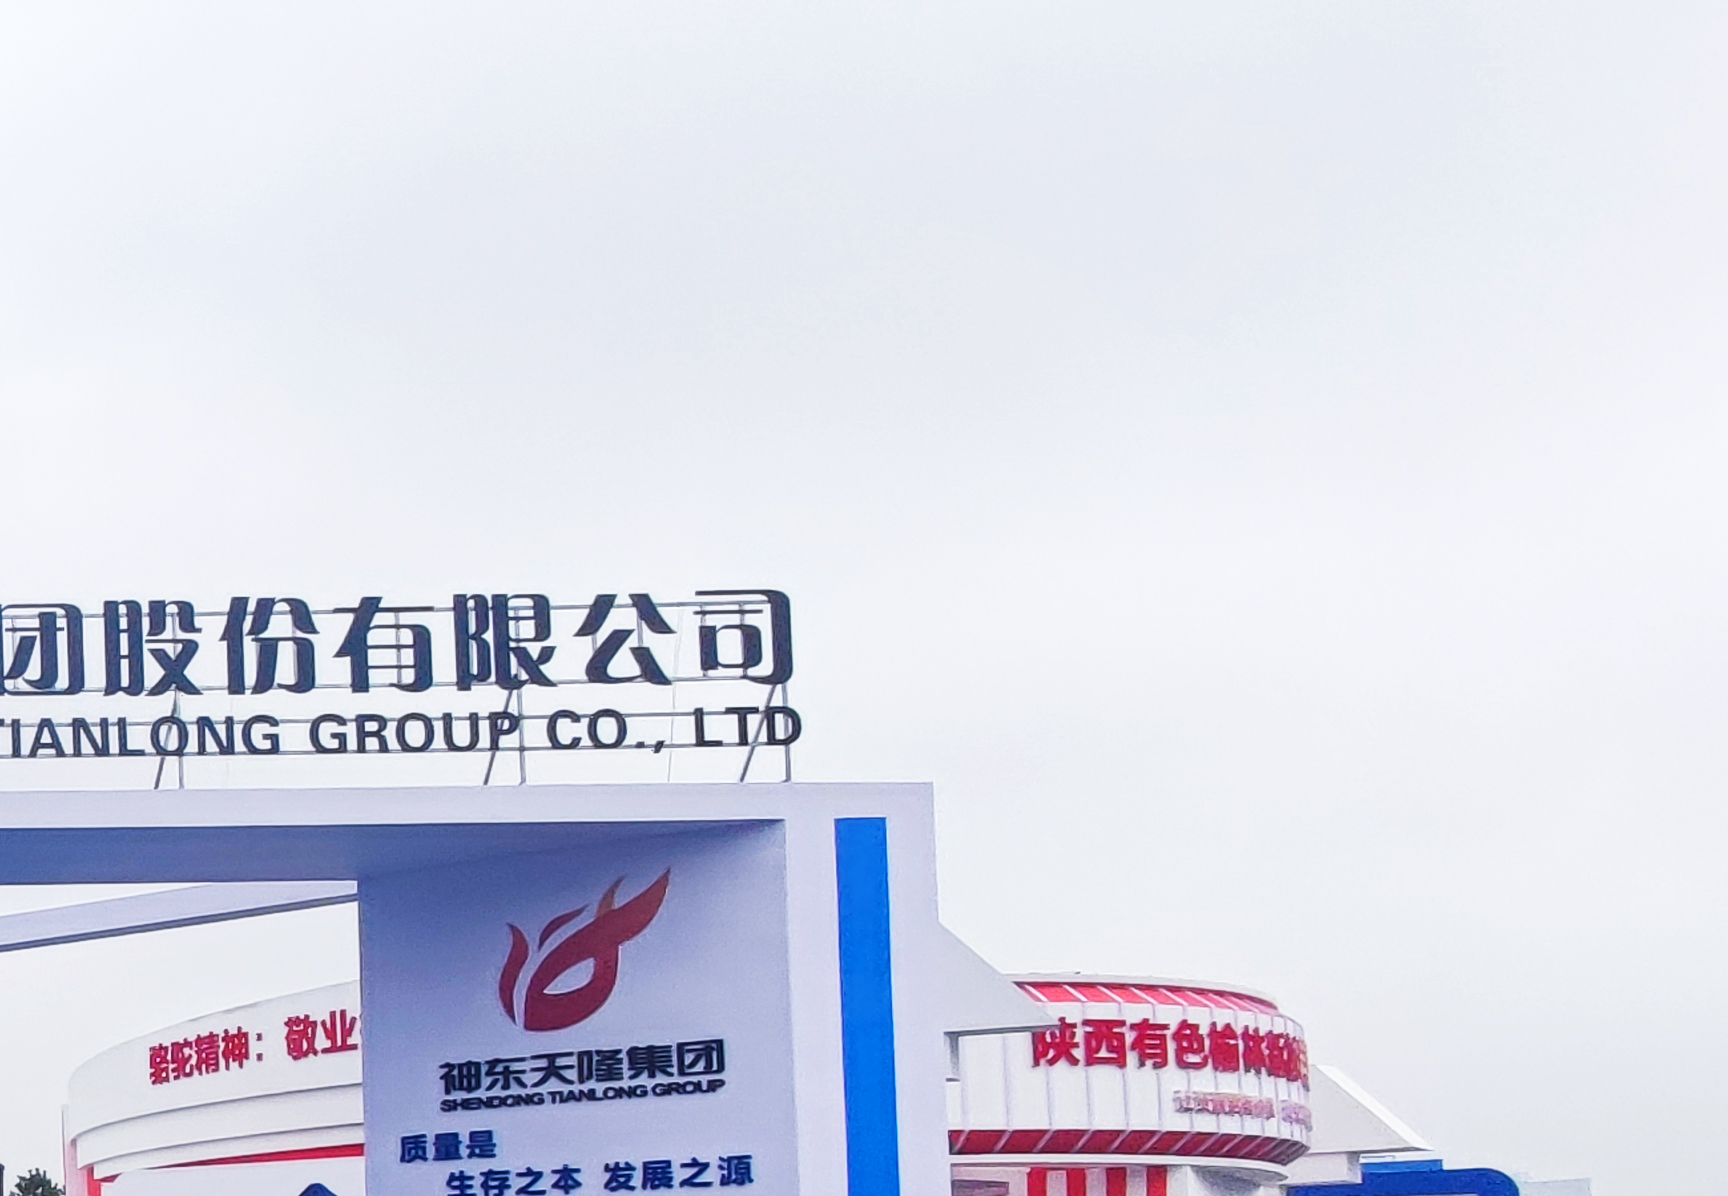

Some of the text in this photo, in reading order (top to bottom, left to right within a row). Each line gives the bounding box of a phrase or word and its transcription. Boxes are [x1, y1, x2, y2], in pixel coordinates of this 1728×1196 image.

[309, 712, 520, 753] GROUP
[546, 708, 666, 754] CO.,
[693, 706, 802, 747] LTD
[439, 1039, 725, 1095] 神东天隆集团
[440, 1079, 725, 1112] SHENDONG TIANLONG GROUP
[399, 1130, 496, 1163] 质量是
[603, 1154, 753, 1192] 发展之源
